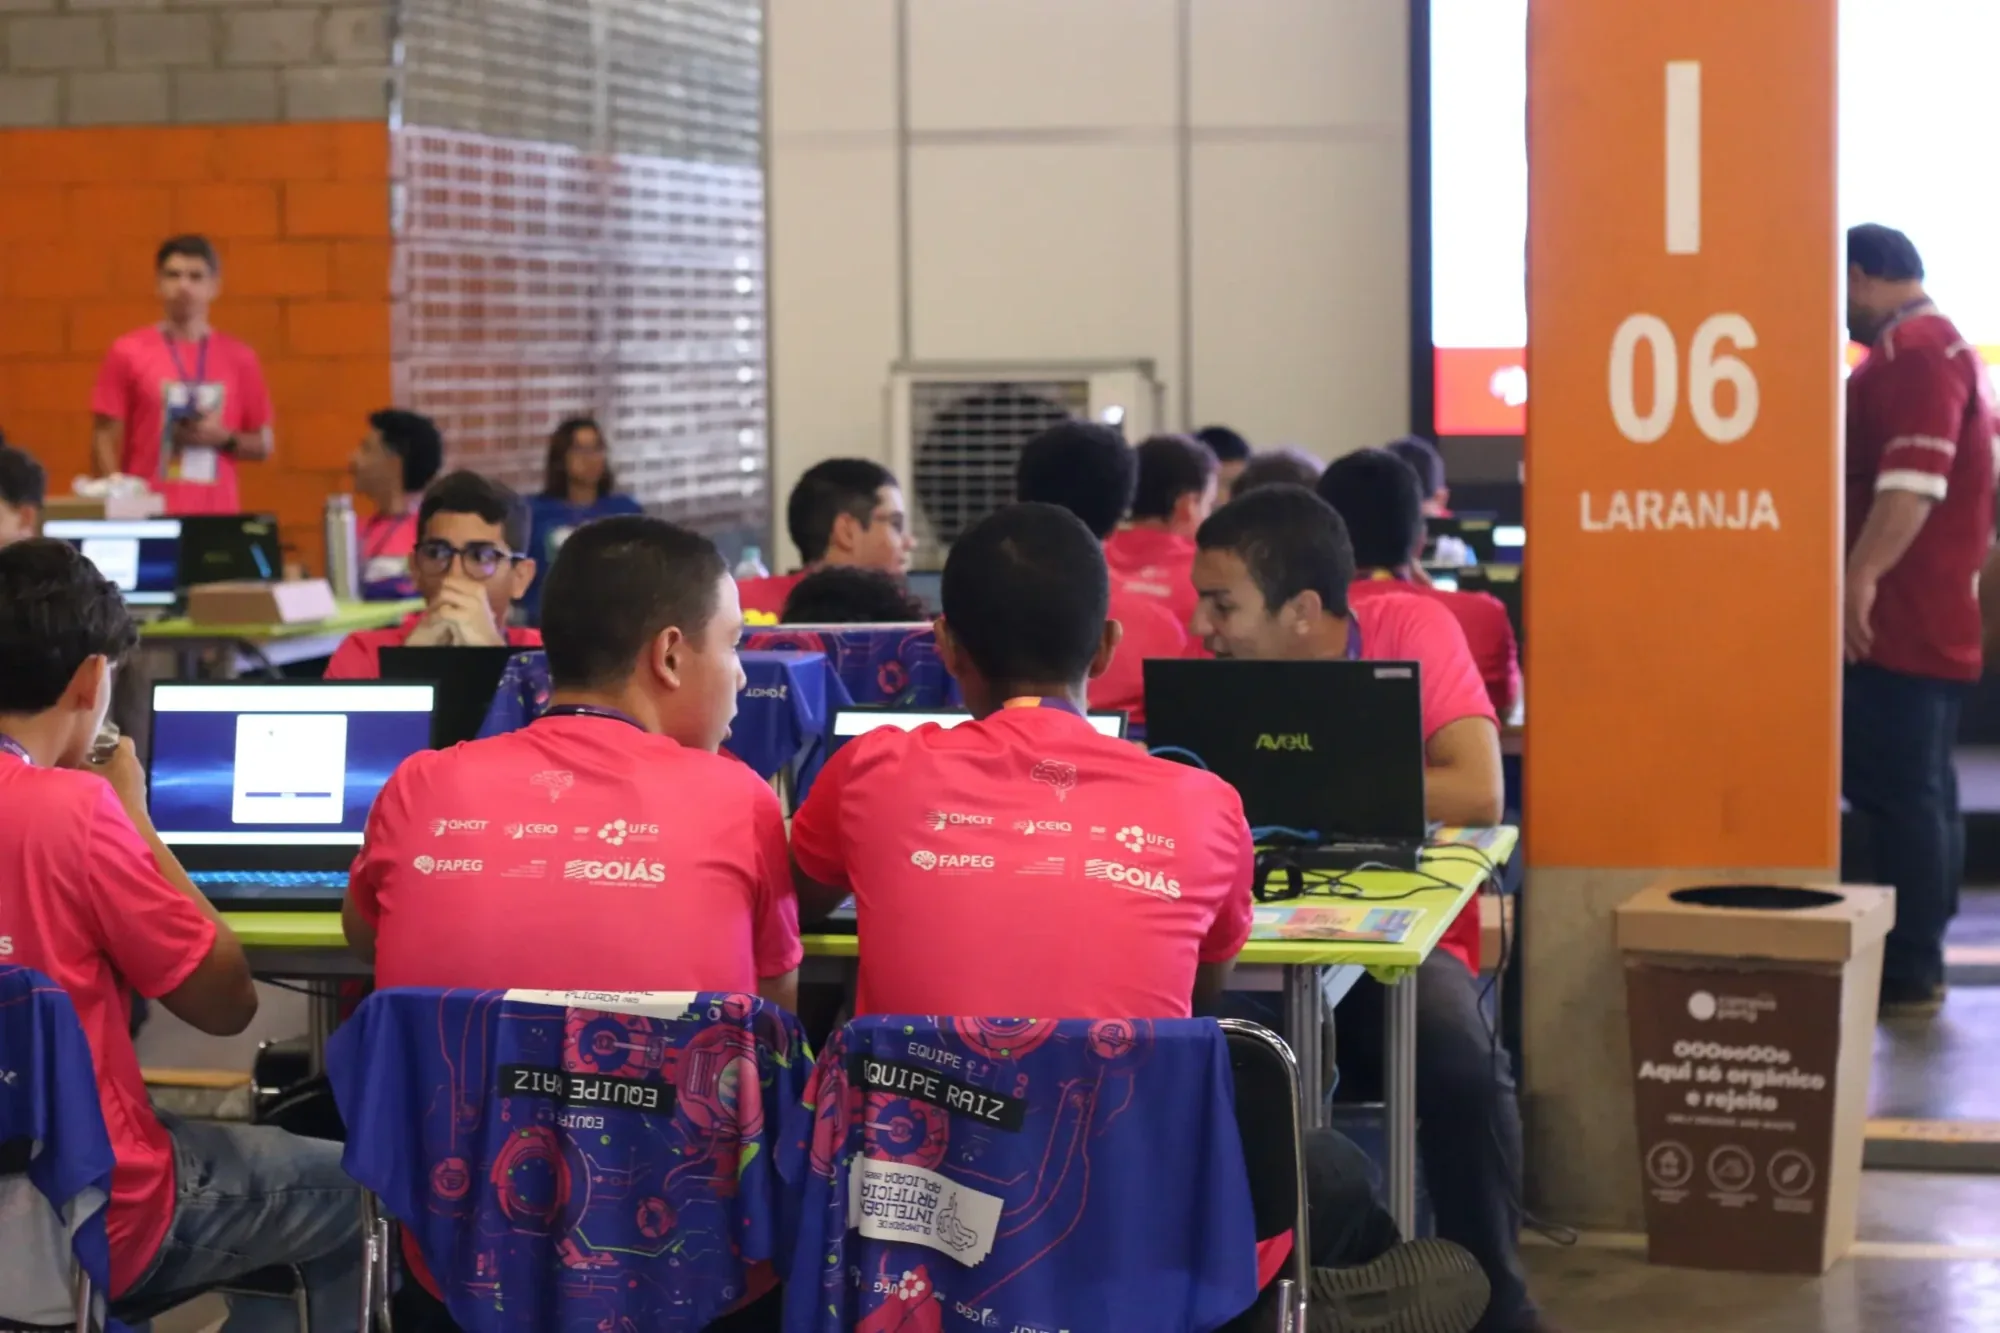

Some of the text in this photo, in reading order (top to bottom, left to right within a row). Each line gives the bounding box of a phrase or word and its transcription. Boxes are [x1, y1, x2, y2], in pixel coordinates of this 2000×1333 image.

[1608, 313, 1760, 443] 06
[1579, 491, 1780, 531] LARANJA
[628, 824, 659, 834] UFG
[1146, 832, 1175, 849] UFG
[436, 859, 483, 872] FAPEG
[584, 858, 665, 882] GOIÁS
[939, 854, 995, 868] FAPEG
[1105, 862, 1181, 899] GOIÁS
[907, 1041, 962, 1070] EQUIPE
[1638, 1060, 1692, 1084] Aqui
[569, 1079, 658, 1108] EQUIPE
[946, 1084, 1005, 1121] RAIZ
[1704, 1088, 1778, 1113] rejeito
[884, 1171, 942, 1194] APLICADA
[861, 1183, 939, 1210] ARTIFICIA
[873, 1281, 899, 1294] UFG
